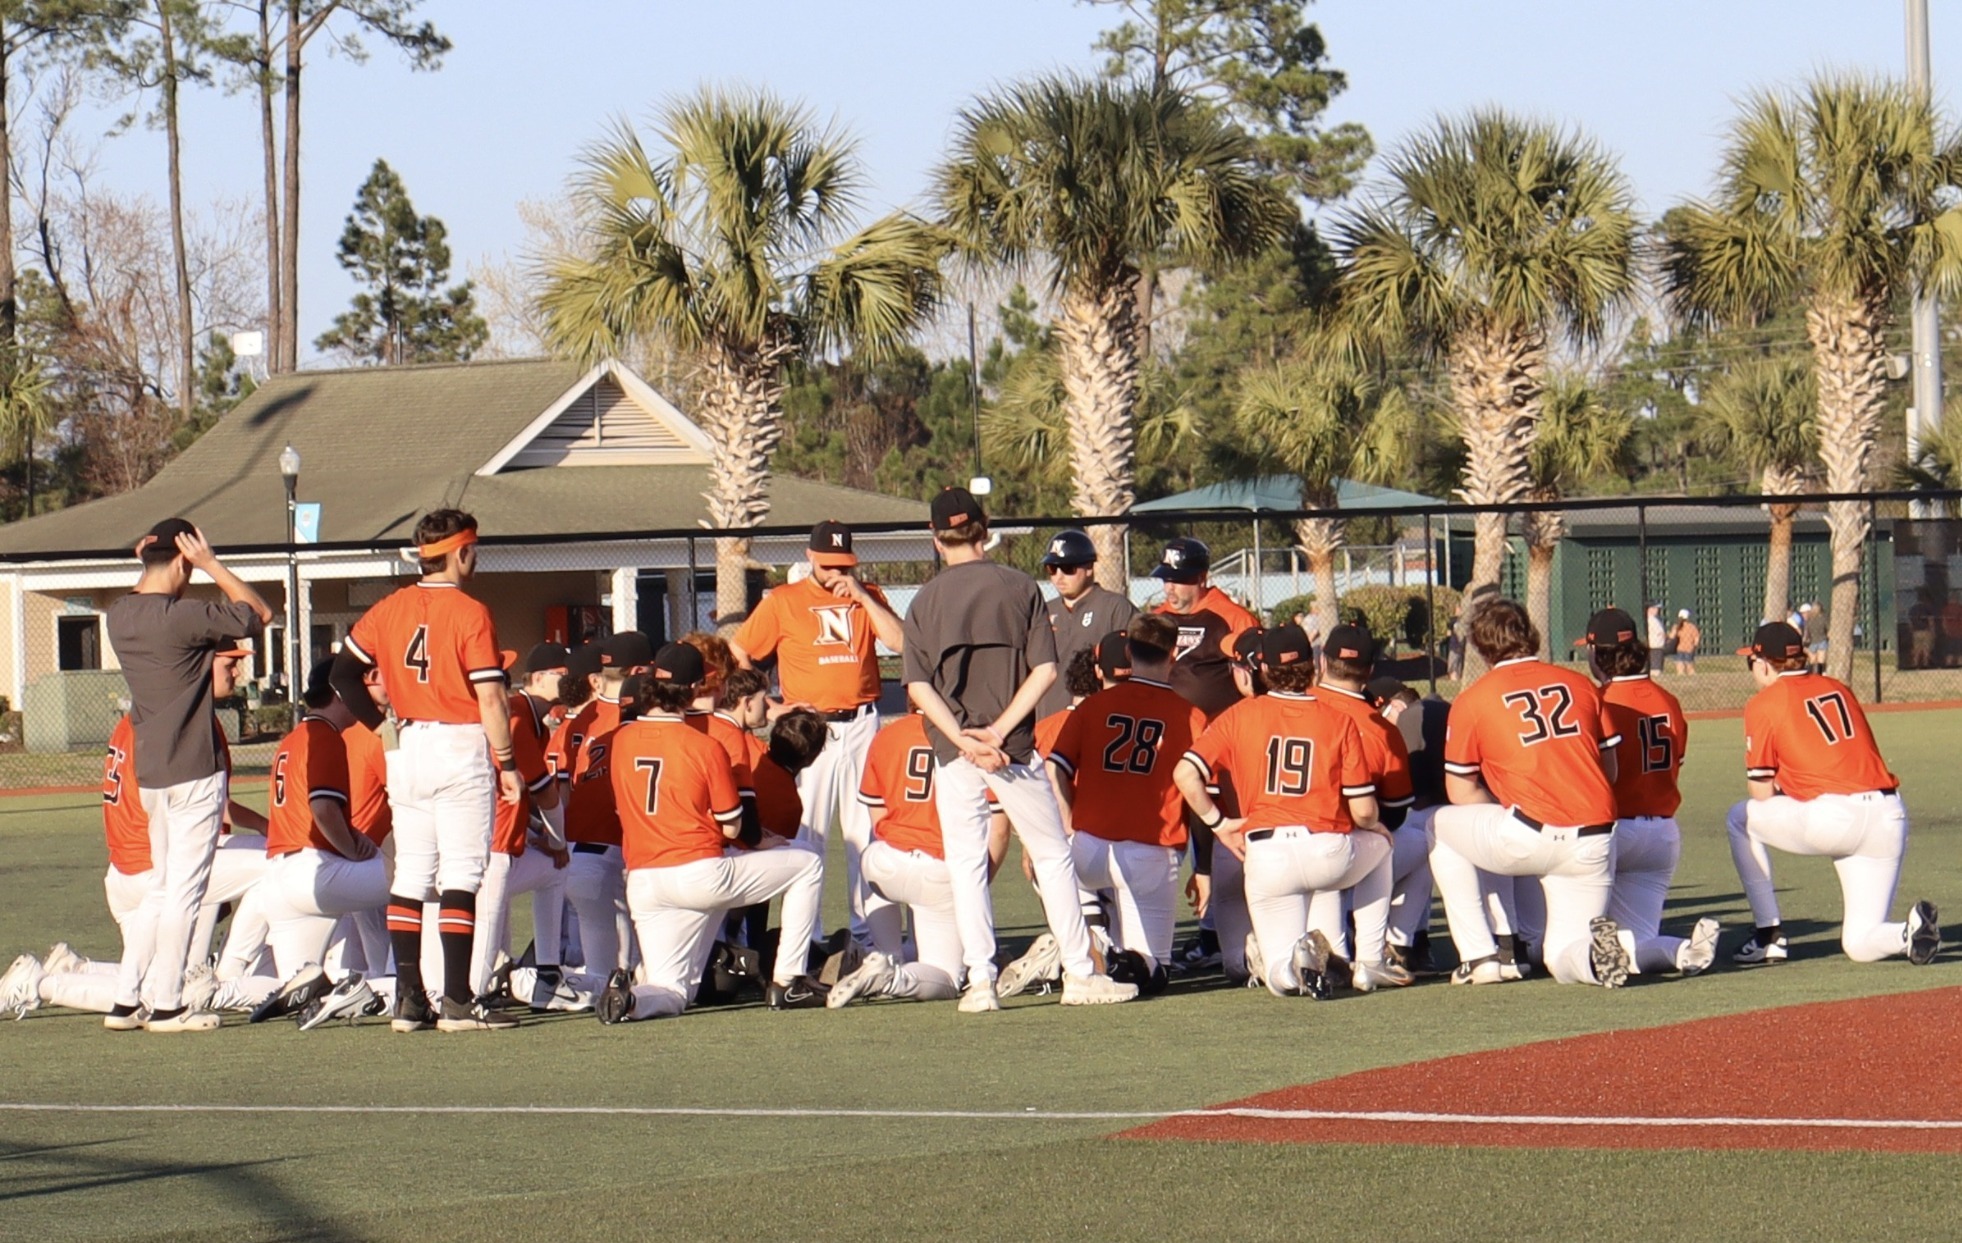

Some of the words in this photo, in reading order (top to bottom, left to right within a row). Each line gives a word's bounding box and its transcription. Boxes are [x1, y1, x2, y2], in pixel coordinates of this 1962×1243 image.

[832, 533, 843, 547] N
[404, 624, 430, 683] 4
[808, 604, 857, 653] N
[1102, 713, 1166, 775] 28
[1502, 682, 1581, 748] 32
[1637, 713, 1673, 775] 15
[1805, 691, 1856, 746] 17
[634, 756, 664, 816] 7
[904, 745, 934, 802] 9
[1264, 735, 1315, 797] 19
